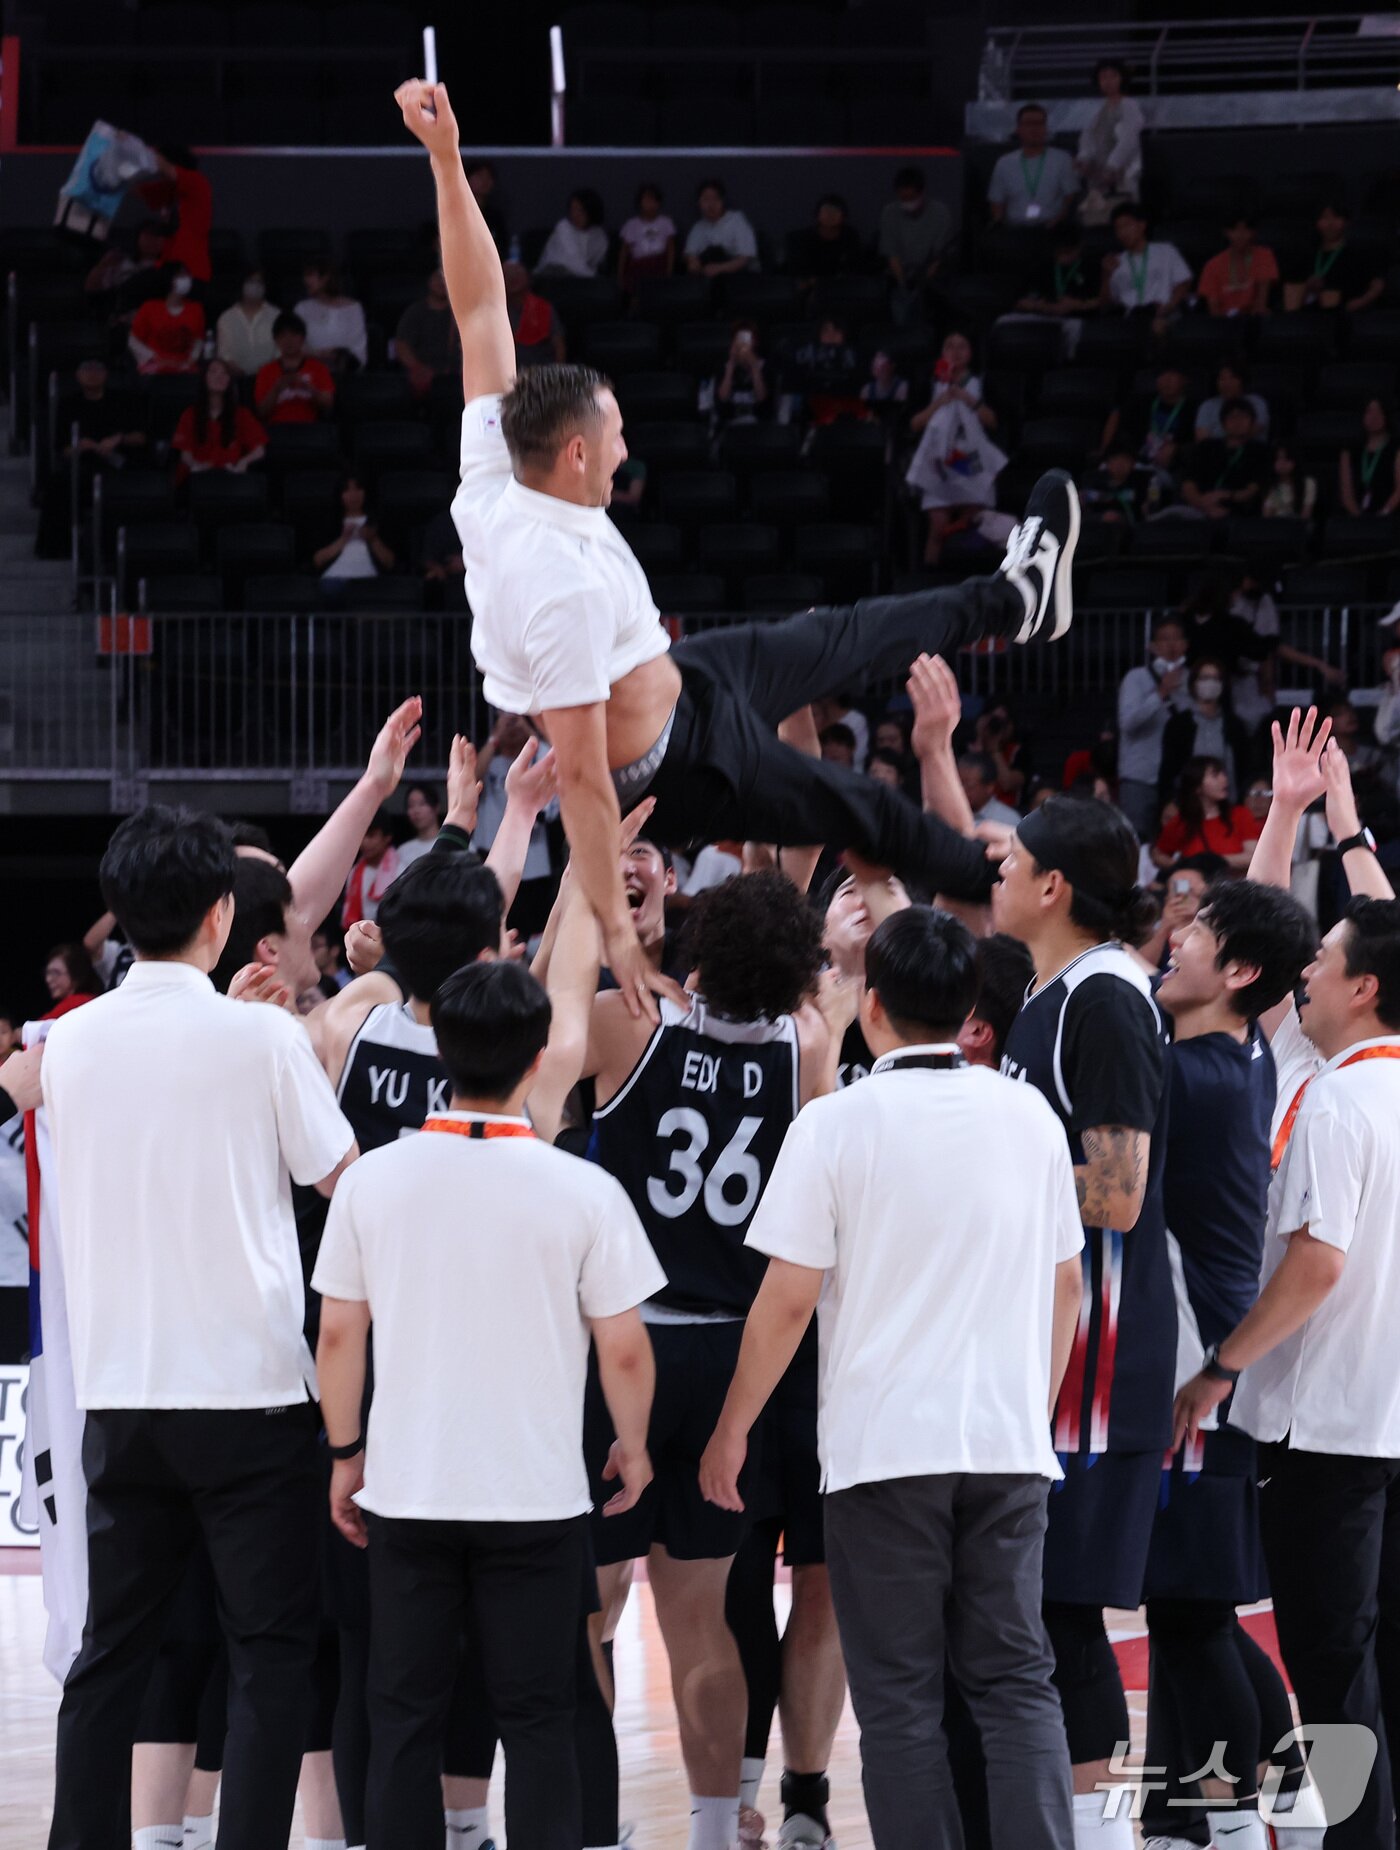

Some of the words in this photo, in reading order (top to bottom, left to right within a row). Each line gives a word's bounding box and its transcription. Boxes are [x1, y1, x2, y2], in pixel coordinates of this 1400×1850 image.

[368, 1064, 411, 1108] YU
[681, 1050, 722, 1093] EDI
[743, 1061, 763, 1098] D
[646, 1106, 765, 1226] 36
